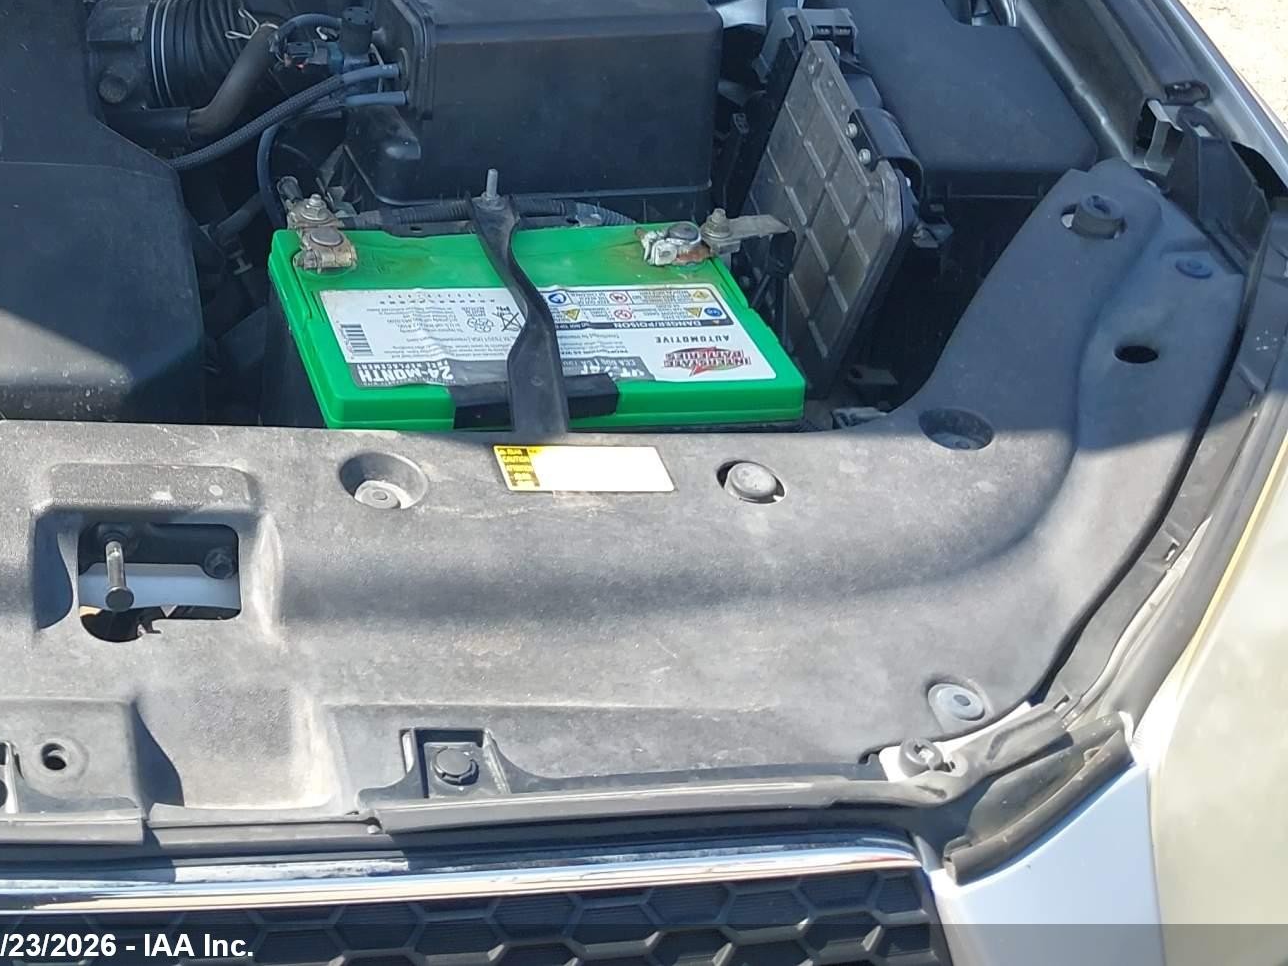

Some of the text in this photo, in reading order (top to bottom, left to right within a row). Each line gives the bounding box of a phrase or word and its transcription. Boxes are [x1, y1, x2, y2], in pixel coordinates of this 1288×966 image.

[615, 321, 701, 329] DANGER/POISON
[656, 335, 730, 343] AUTOMOTIVE
[665, 348, 744, 360] BATTERIES
[664, 356, 751, 368] INTERSTATE
[358, 365, 454, 383] 24-MONTH
